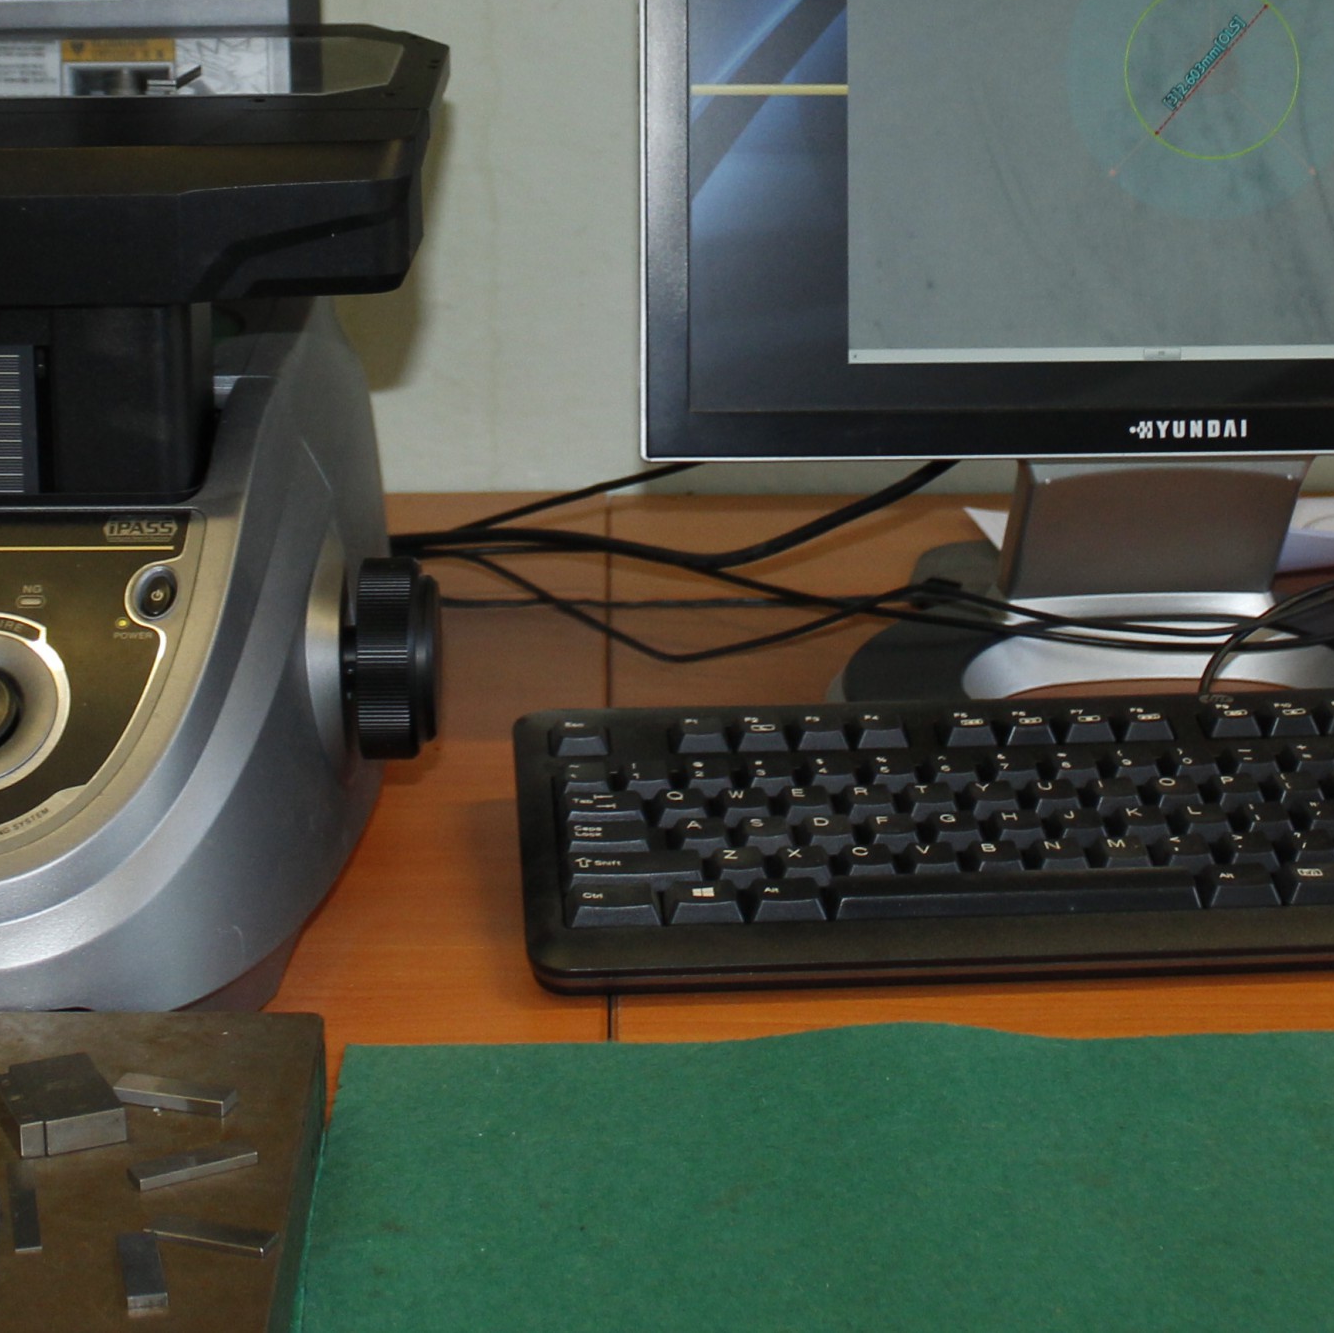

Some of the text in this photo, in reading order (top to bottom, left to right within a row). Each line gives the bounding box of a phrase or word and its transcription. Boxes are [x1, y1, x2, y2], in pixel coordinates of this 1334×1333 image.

[1130, 419, 1248, 439] HYUNDAI
[22, 584, 43, 594] NG
[113, 631, 154, 641] POWER
[666, 790, 685, 802] Q
[728, 790, 746, 800] W
[791, 787, 806, 798] E
[12, 807, 50, 831] SYSTEM
[812, 817, 830, 827] D
[1106, 837, 1128, 849] M
[593, 858, 622, 868] Shift
[582, 891, 604, 900] Ctrl
